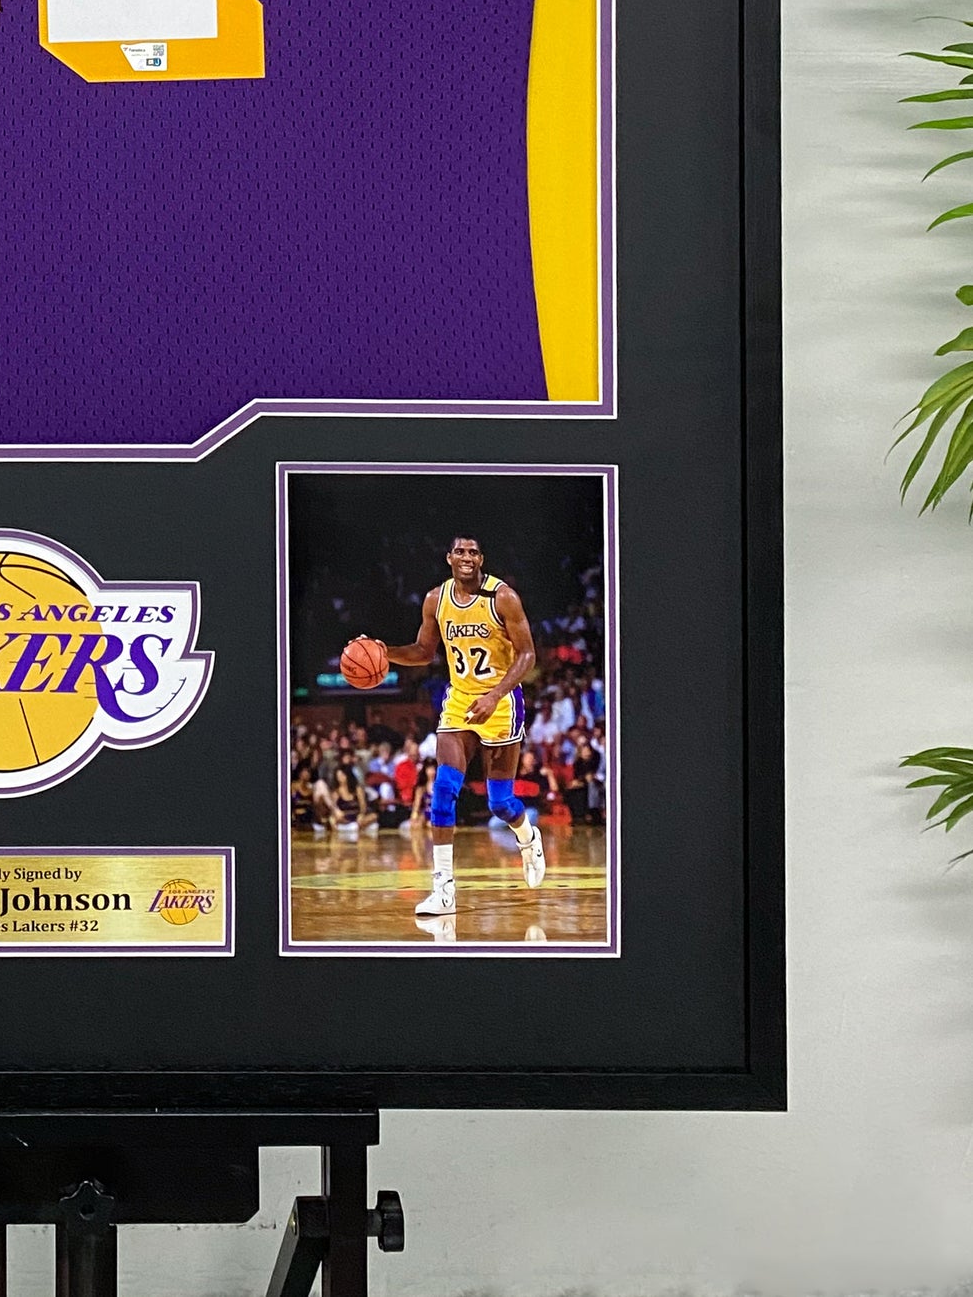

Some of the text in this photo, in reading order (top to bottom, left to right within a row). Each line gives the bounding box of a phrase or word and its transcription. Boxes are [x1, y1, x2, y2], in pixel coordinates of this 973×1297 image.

[17, 605, 176, 623] ANGELES
[446, 620, 492, 641] LAKERS
[450, 646, 495, 679] 32
[13, 868, 61, 882] Signed
[65, 868, 82, 881] by
[0, 887, 132, 917] Johnson
[146, 889, 218, 915] LAKERS
[13, 920, 65, 932] Lakers
[69, 920, 99, 932] #32
